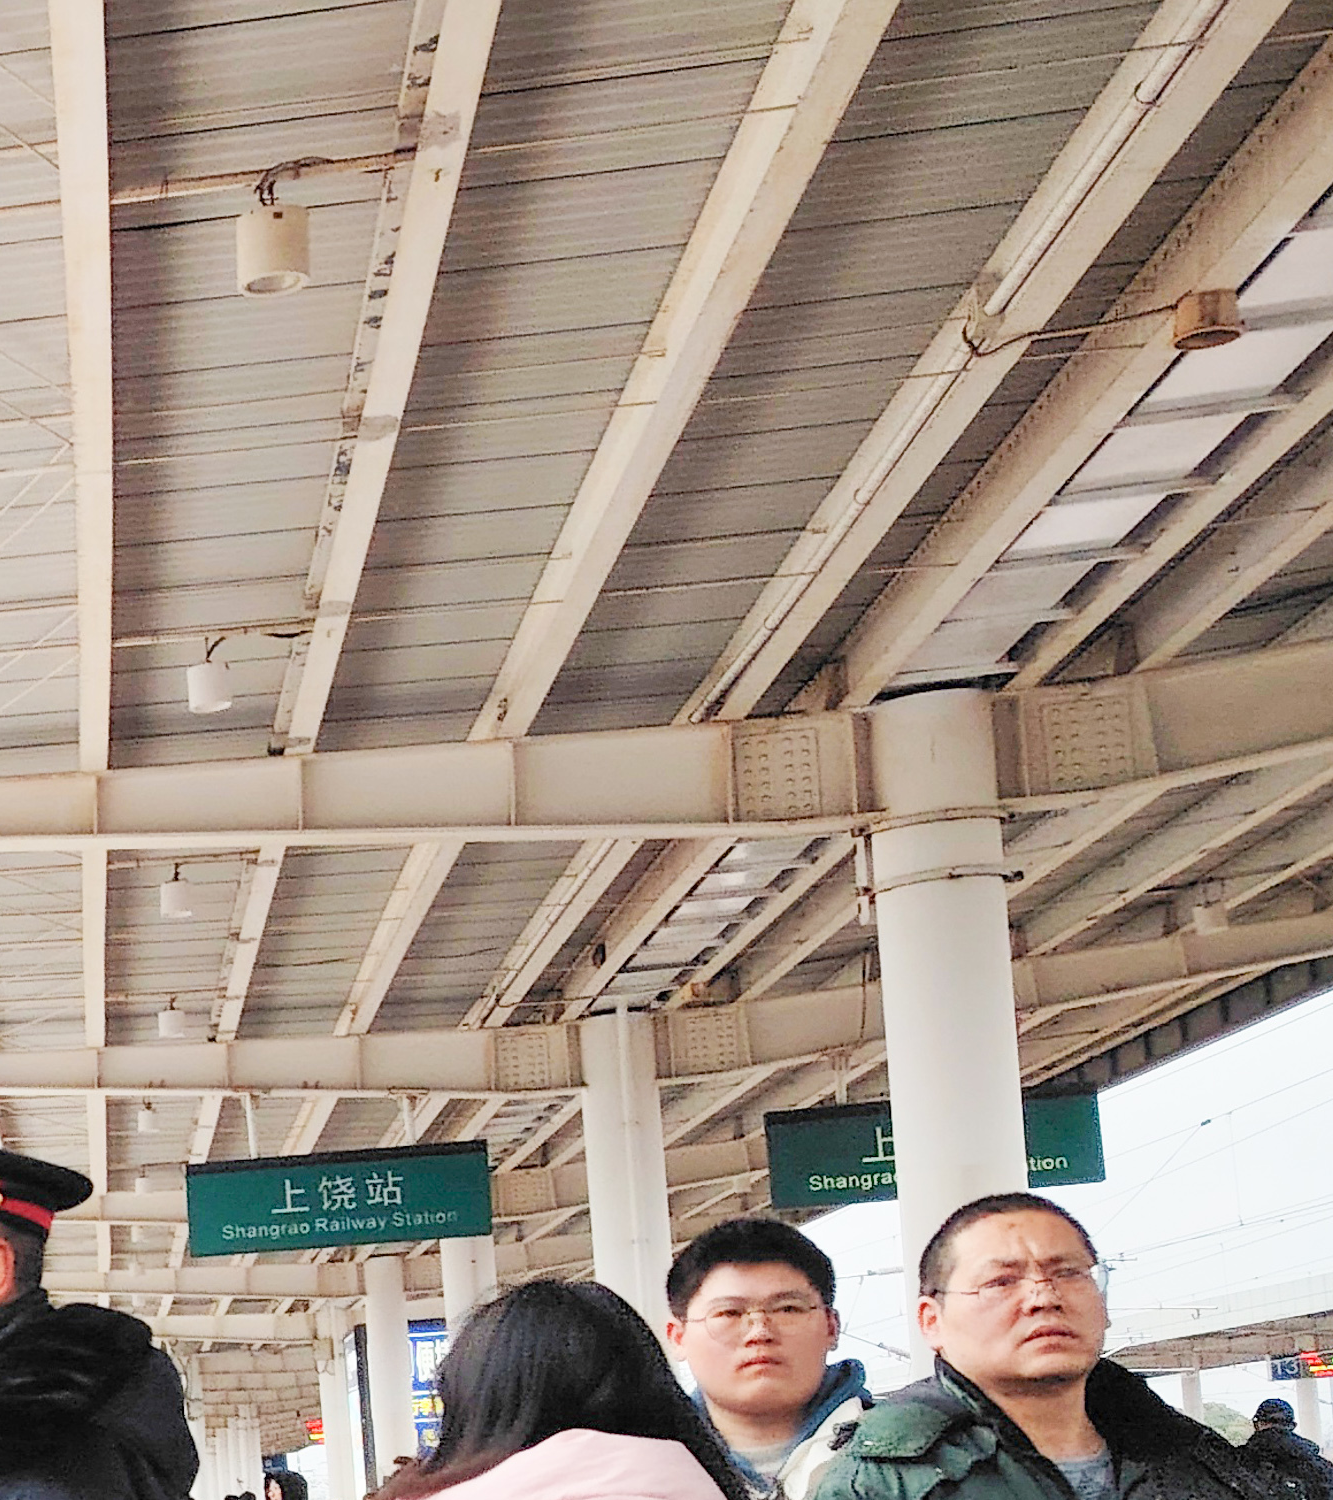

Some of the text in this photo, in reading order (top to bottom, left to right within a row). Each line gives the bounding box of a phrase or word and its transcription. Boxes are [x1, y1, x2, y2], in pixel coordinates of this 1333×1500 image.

[271, 1170, 404, 1214] 上饶站
[222, 1208, 458, 1241] Shangrao Railway Station
